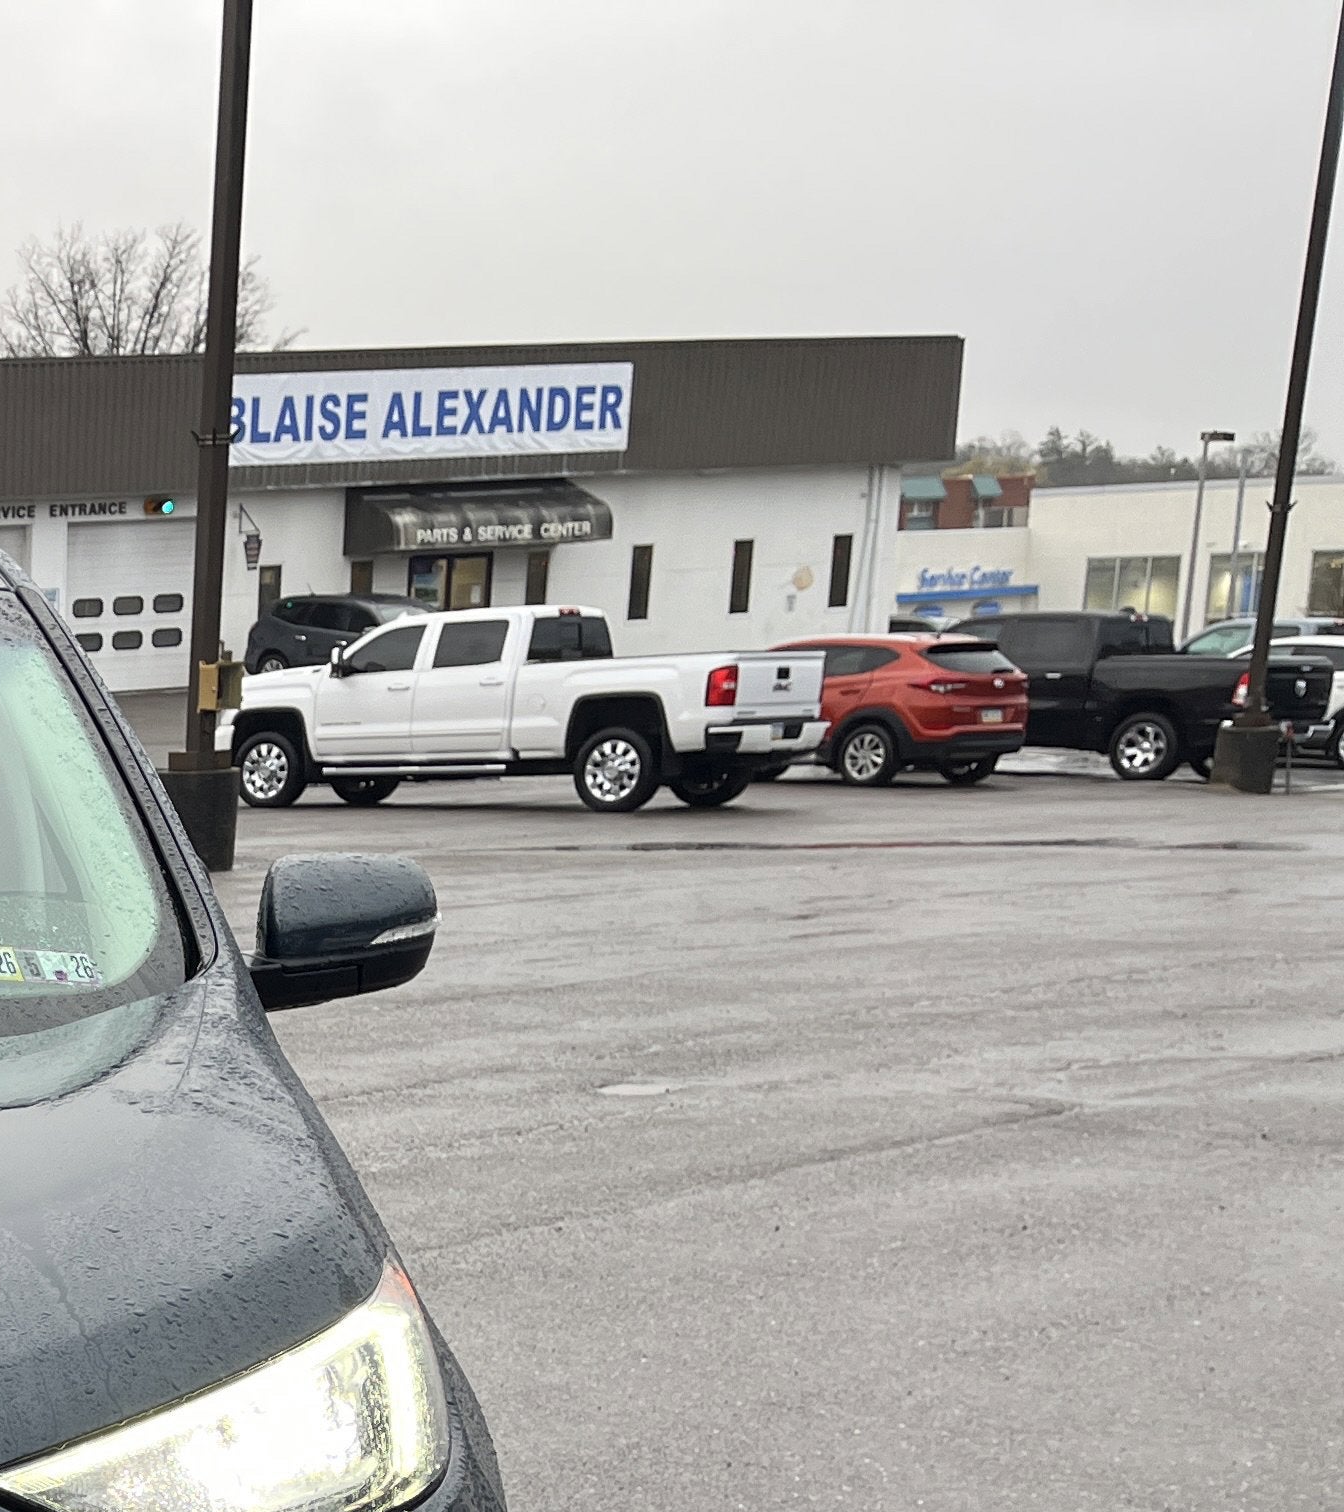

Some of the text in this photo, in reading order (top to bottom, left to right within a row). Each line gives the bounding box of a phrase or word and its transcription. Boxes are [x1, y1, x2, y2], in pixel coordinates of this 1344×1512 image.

[229, 384, 624, 444] BLAISE ALEXANDER
[49, 501, 128, 518] ENTRANCE
[416, 520, 592, 543] PARTS & SERVICE CENTER
[70, 955, 95, 979] 26
